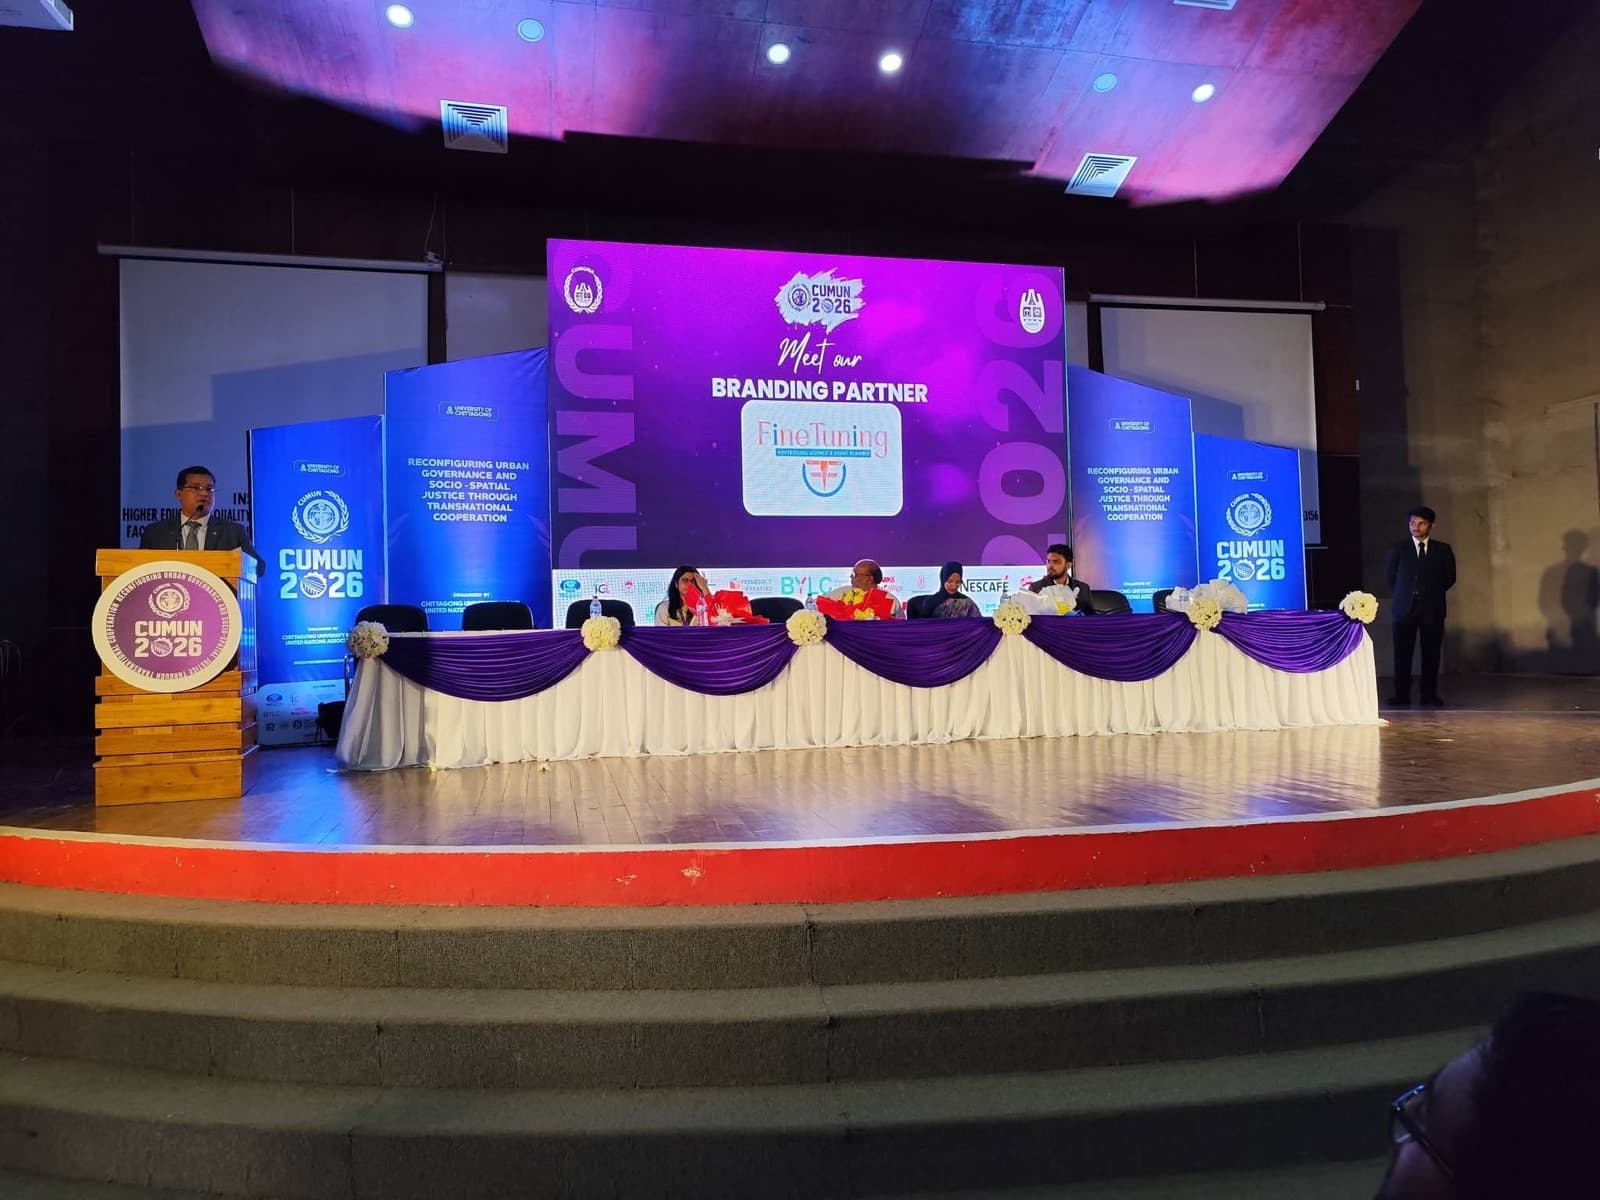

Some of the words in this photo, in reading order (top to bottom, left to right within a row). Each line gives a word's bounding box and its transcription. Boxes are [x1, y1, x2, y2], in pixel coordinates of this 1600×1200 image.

[812, 284, 851, 298] CUMUN
[812, 297, 851, 314] 2026
[778, 331, 836, 375] Meet
[833, 355, 863, 368] our
[711, 377, 829, 400] BRANDING
[832, 381, 929, 403] PARTNER
[757, 420, 888, 459] FineTuning
[408, 458, 493, 469] RECONFIGURING
[496, 461, 529, 470] URBAN
[1088, 467, 1151, 475] RECONFIGURING
[1153, 467, 1179, 475] URBAN
[422, 469, 493, 479] GOVERNANCE
[1098, 477, 1151, 485] GOVERNANCE
[1153, 476, 1170, 484] AND
[298, 490, 322, 506] CUMUN
[422, 491, 465, 500] JUSTICE
[467, 492, 518, 501] THROUGH
[123, 508, 157, 521] HIGHER
[427, 502, 513, 512] TRANSNATIONAL
[1102, 504, 1168, 512] TRANSNATIONAL
[433, 513, 507, 522] COOPERATION
[1107, 513, 1163, 521] COOPERATION
[1217, 540, 1284, 558] CUMUN
[279, 549, 363, 570] CUMUN
[1217, 558, 1286, 581] 2026
[280, 571, 363, 599] 2026
[781, 576, 832, 596] BYLC
[134, 620, 203, 637] CUMUN
[134, 637, 203, 658] 2026
